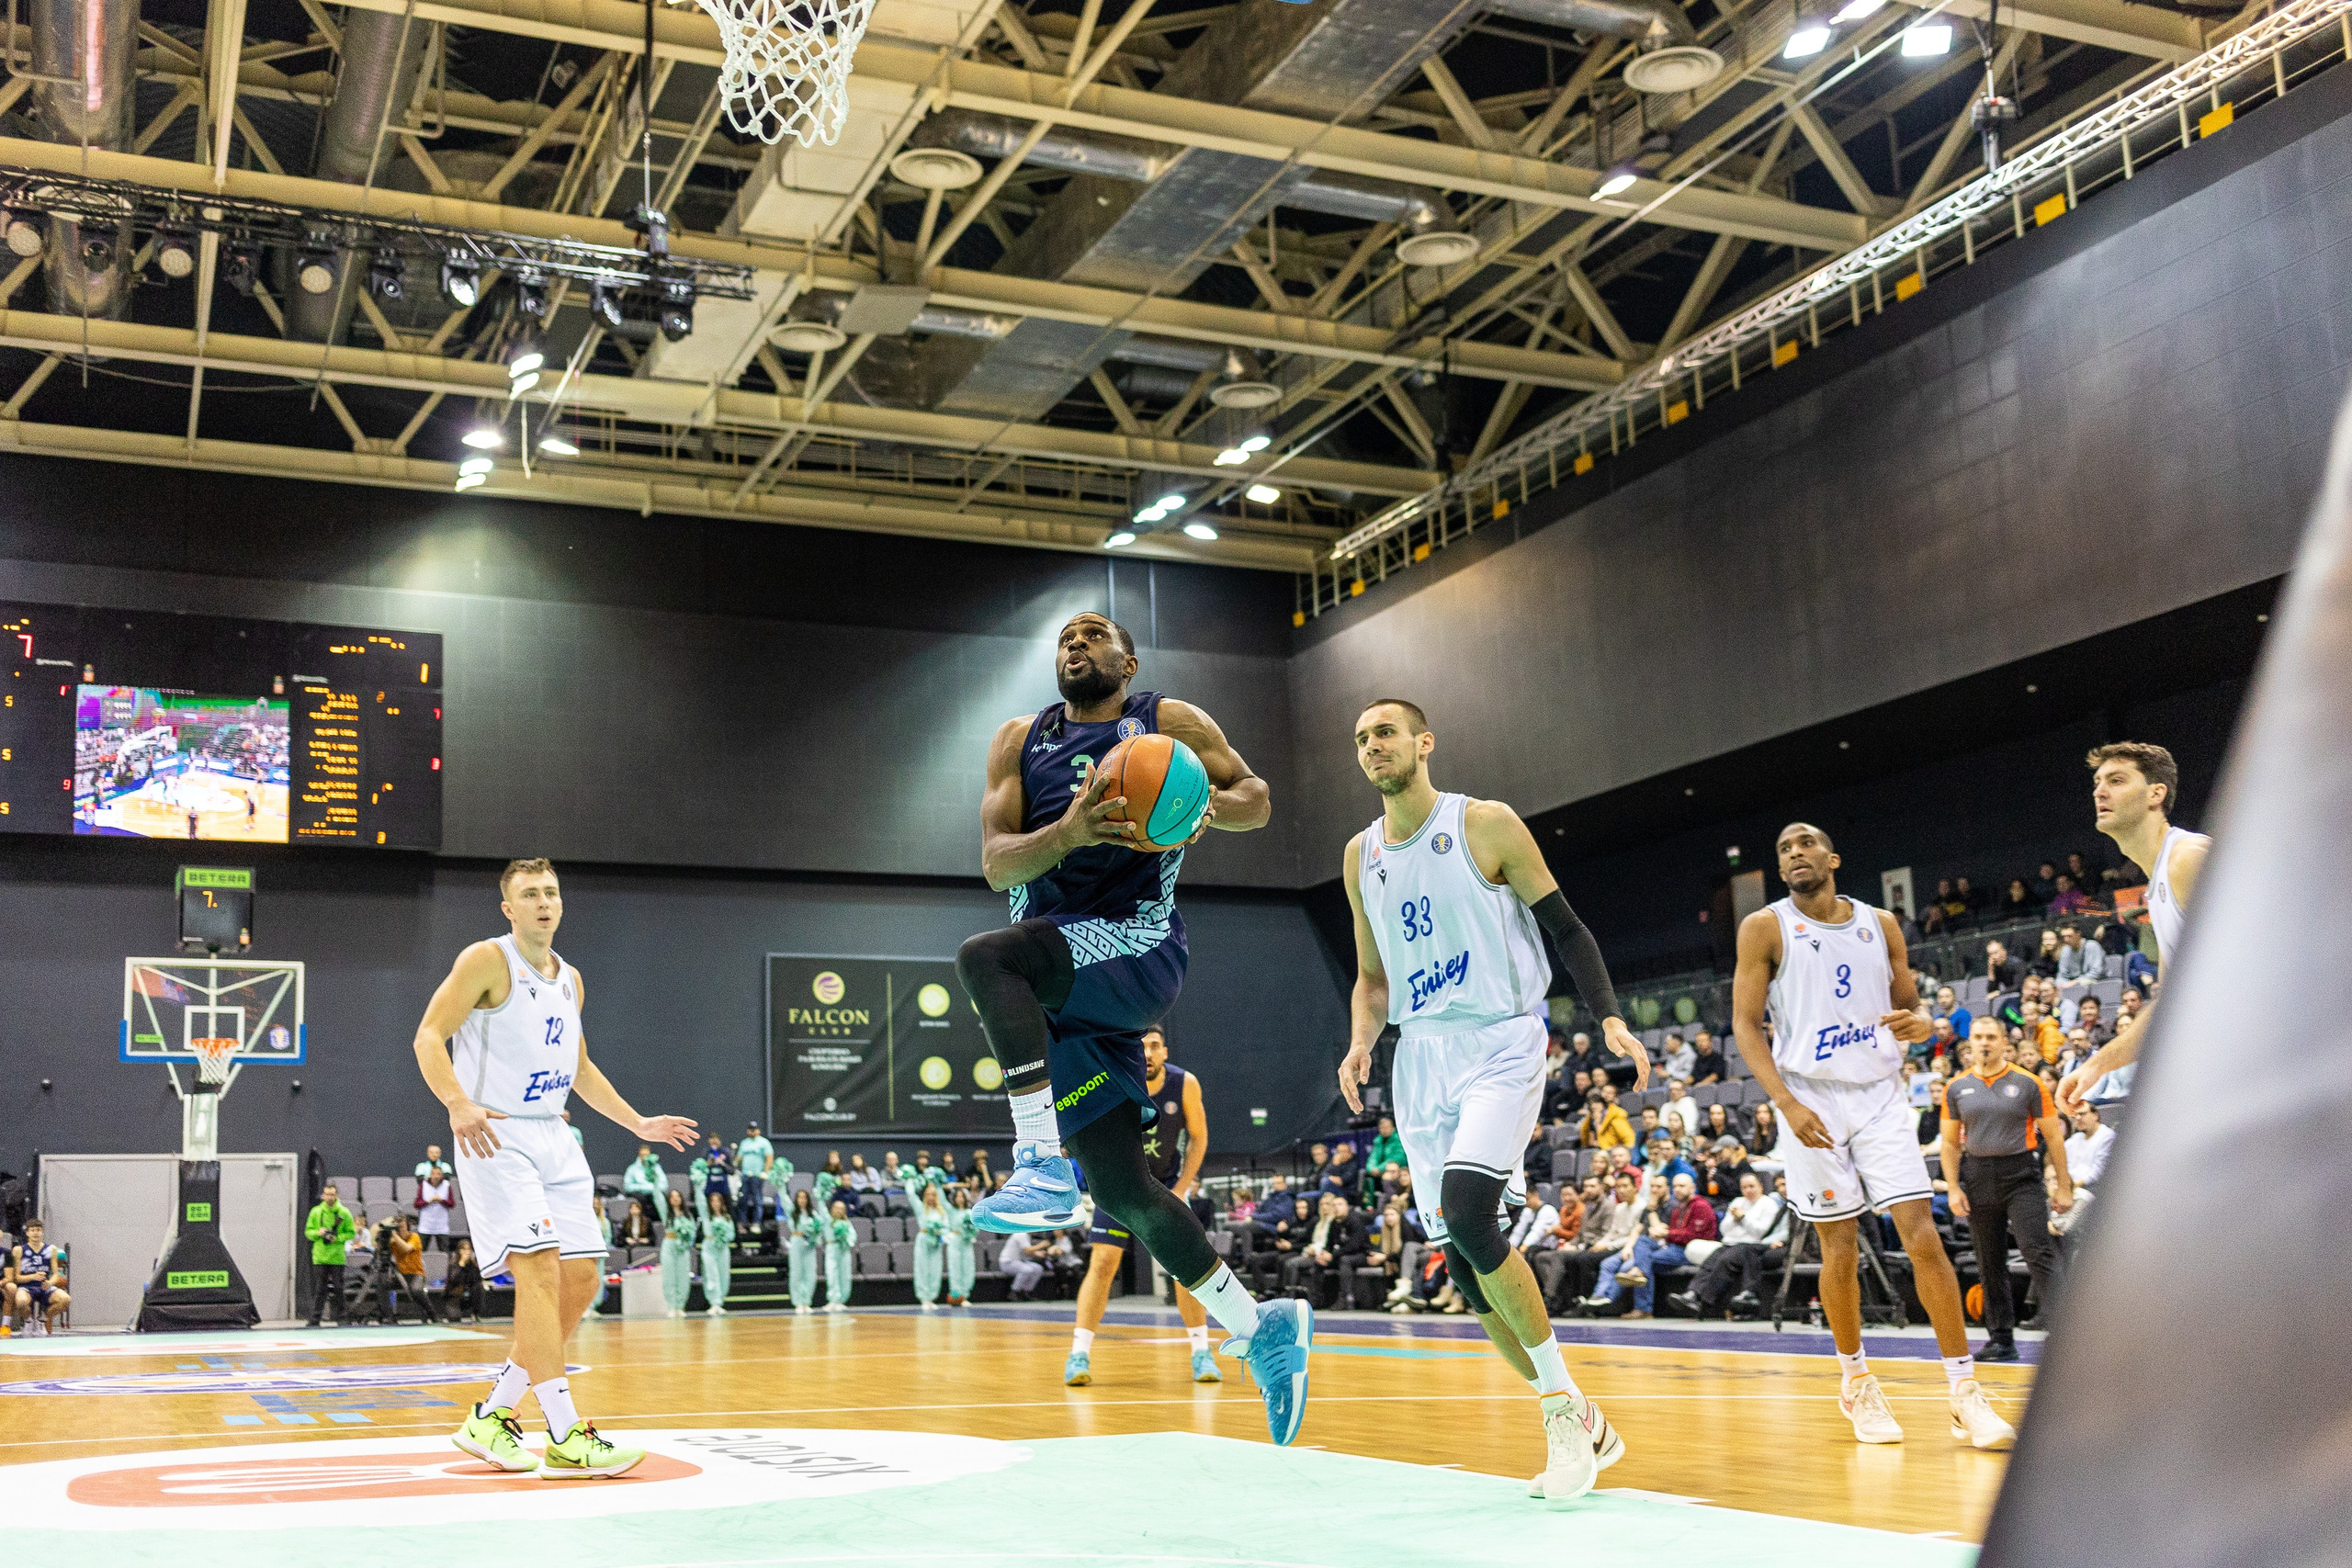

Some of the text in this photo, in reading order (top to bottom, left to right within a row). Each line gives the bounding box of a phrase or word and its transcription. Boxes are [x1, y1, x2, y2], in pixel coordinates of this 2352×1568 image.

[1031, 743, 1062, 753] kmp
[189, 873, 246, 882] BETERA
[1401, 896, 1433, 942] 33
[1835, 964, 1851, 998] 3
[788, 1009, 869, 1024] FALCON
[545, 1016, 564, 1046] 12
[1007, 1059, 1045, 1077] BLINDSAVE
[171, 1274, 225, 1285] BETERA
